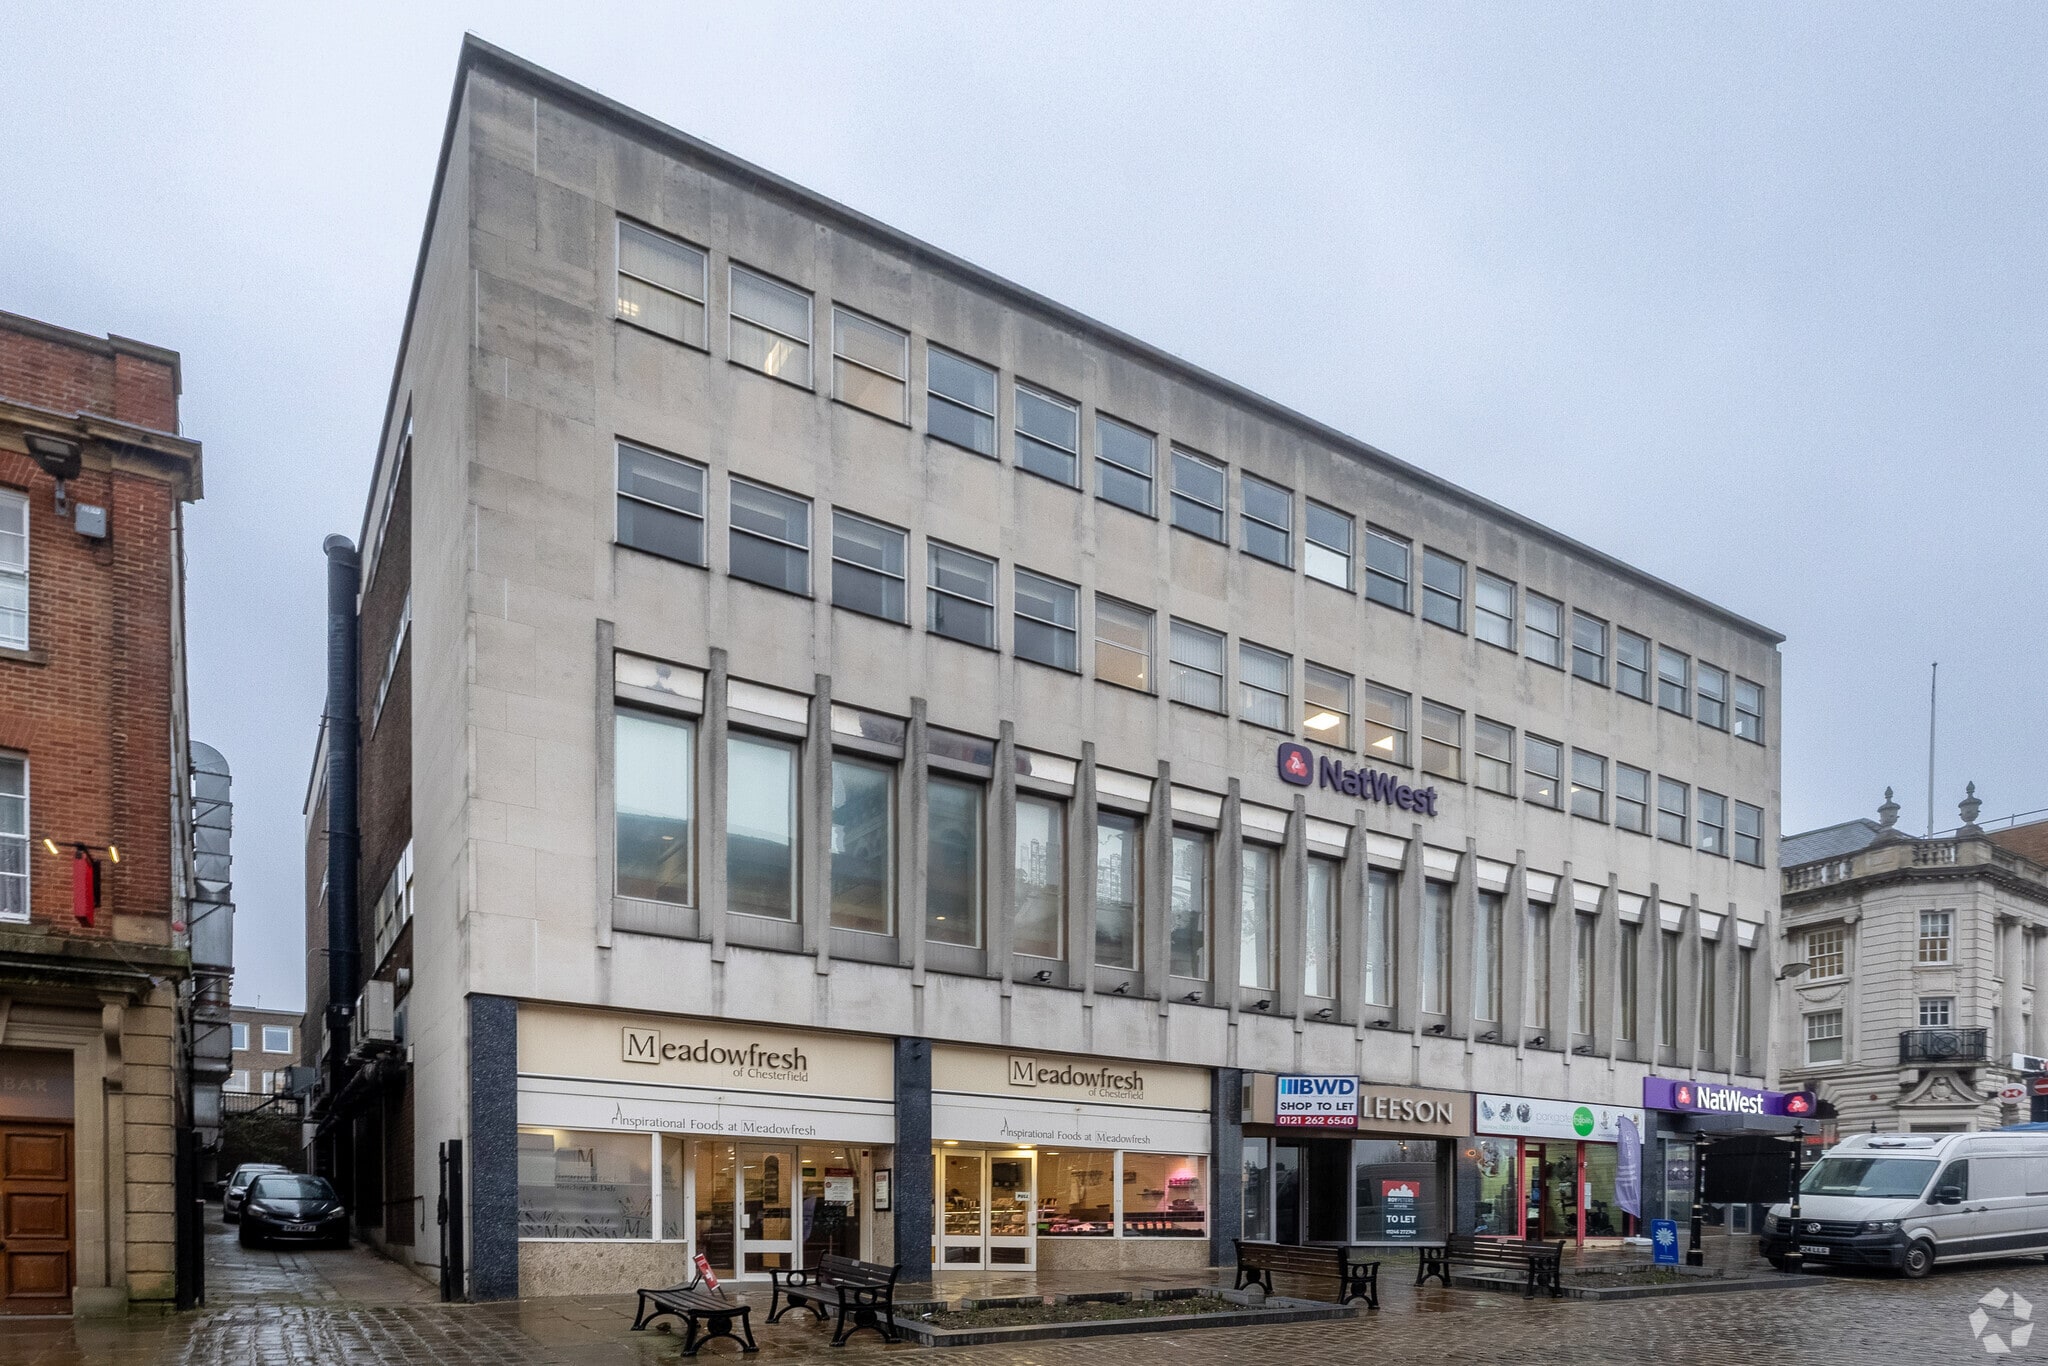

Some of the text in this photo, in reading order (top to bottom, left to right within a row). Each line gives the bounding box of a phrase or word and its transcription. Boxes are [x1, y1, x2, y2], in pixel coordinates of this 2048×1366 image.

[1320, 755, 1438, 816] NatWest
[627, 1033, 808, 1071] Meadowfresh
[732, 1068, 809, 1082] of Chesterfield
[1013, 1060, 1144, 1090] Meadowfresh
[1088, 1088, 1144, 1100] of Chesterfield
[1300, 1079, 1355, 1095] BWD
[1280, 1102, 1354, 1110] SHOP TO LET
[1697, 1086, 1764, 1114] NatWest
[1362, 1096, 1453, 1124] LEESON
[690, 1119, 724, 1131] Foods
[728, 1122, 738, 1132] at
[743, 1122, 816, 1136] Meadowfresh
[1280, 1116, 1354, 1124] 0121 262 6540
[1057, 1131, 1082, 1141] Foods
[1084, 1133, 1092, 1141] at
[1097, 1132, 1151, 1145] Meadowfresh
[1386, 1215, 1416, 1223] TO LET
